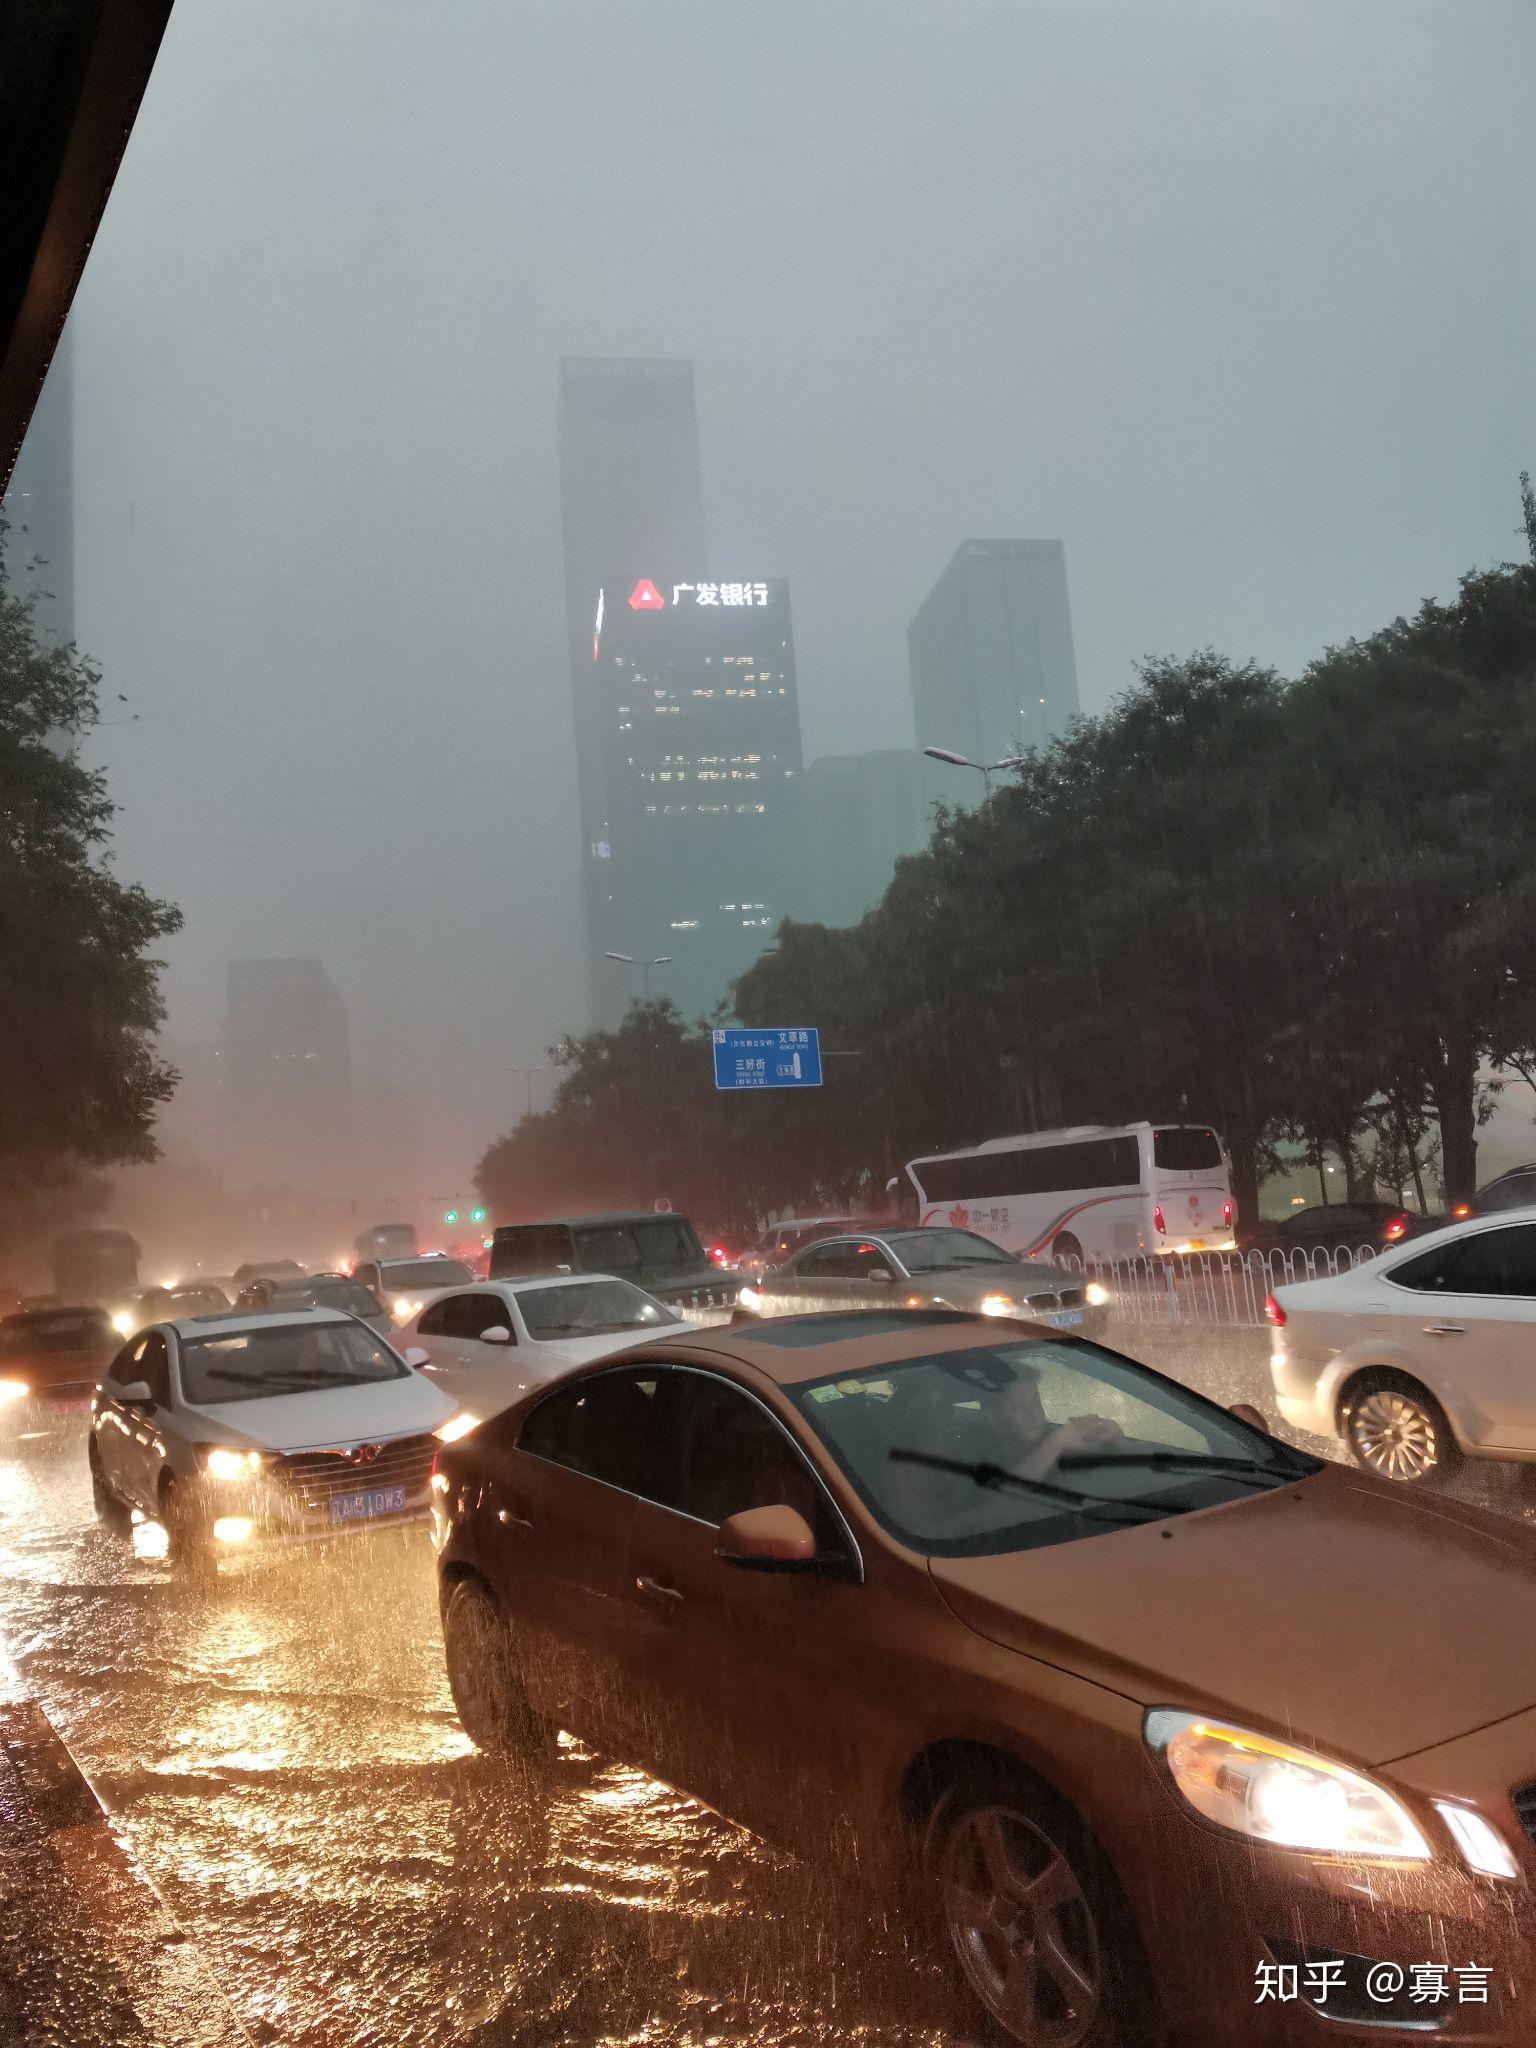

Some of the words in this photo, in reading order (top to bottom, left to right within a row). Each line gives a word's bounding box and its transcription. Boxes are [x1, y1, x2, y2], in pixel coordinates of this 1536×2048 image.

[672, 582, 768, 606] 广发银行
[735, 1058, 765, 1071] 三好街
